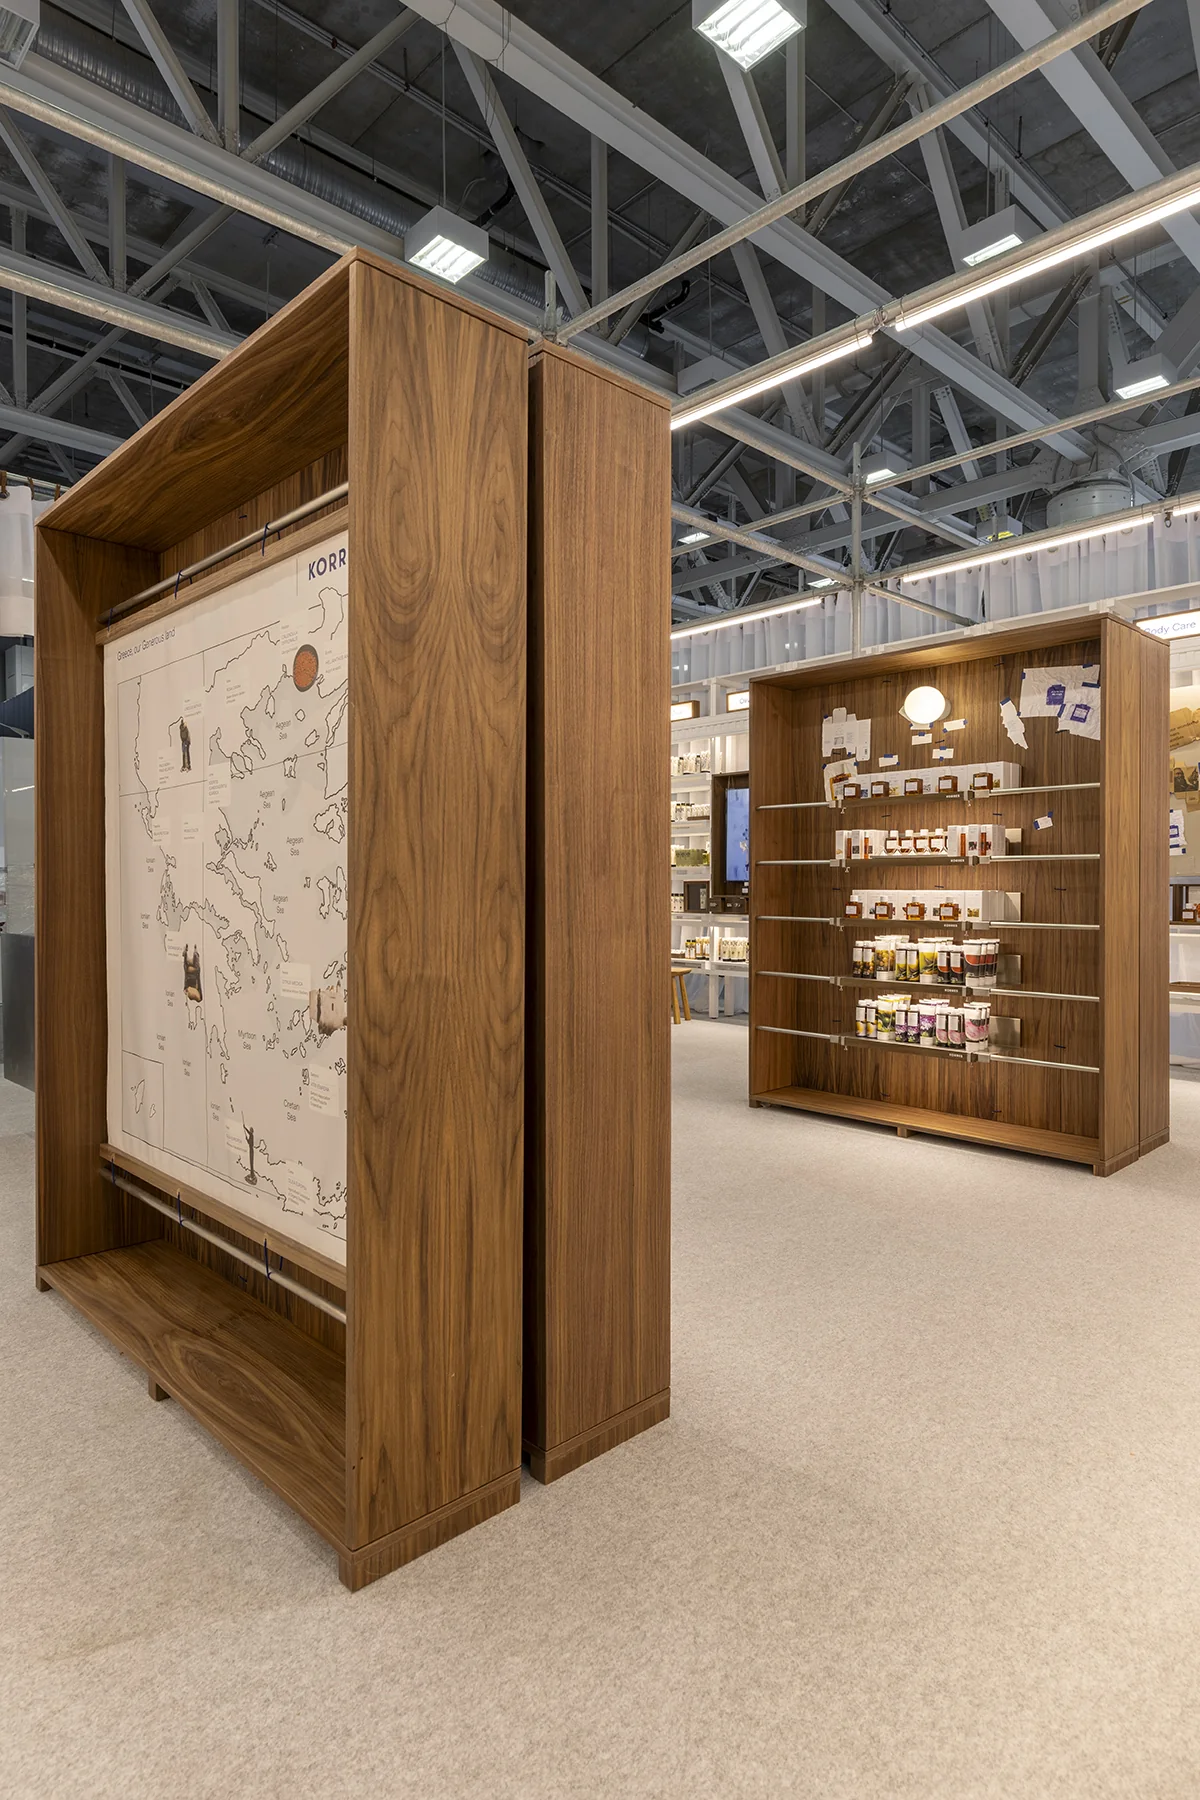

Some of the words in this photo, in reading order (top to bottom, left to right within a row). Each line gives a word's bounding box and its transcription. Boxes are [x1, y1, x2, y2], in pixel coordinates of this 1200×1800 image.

[308, 548, 347, 581] KORR
[1172, 621, 1197, 632] Care
[142, 634, 164, 650] Generous
